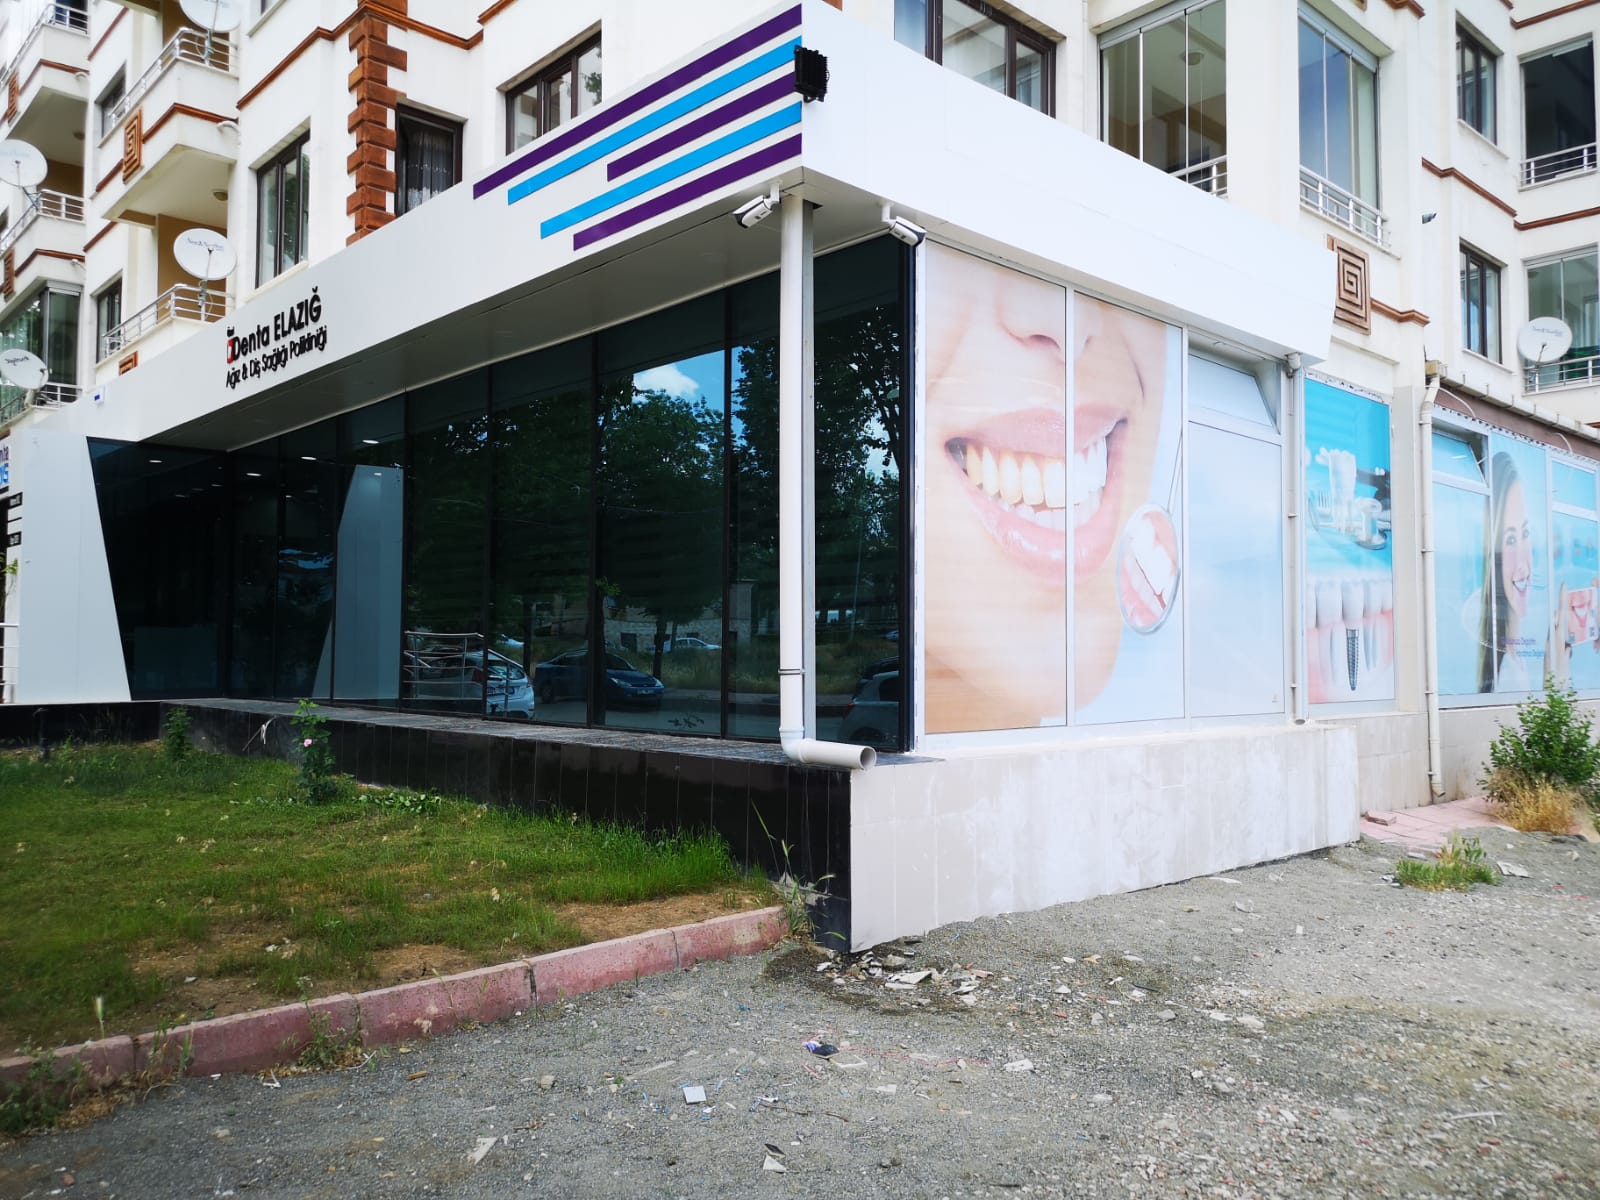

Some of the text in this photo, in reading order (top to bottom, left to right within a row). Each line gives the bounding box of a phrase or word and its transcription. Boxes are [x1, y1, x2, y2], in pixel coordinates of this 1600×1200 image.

[273, 286, 322, 341] ELAZIĞ
[242, 363, 248, 380] &
[249, 358, 261, 378] Diş
